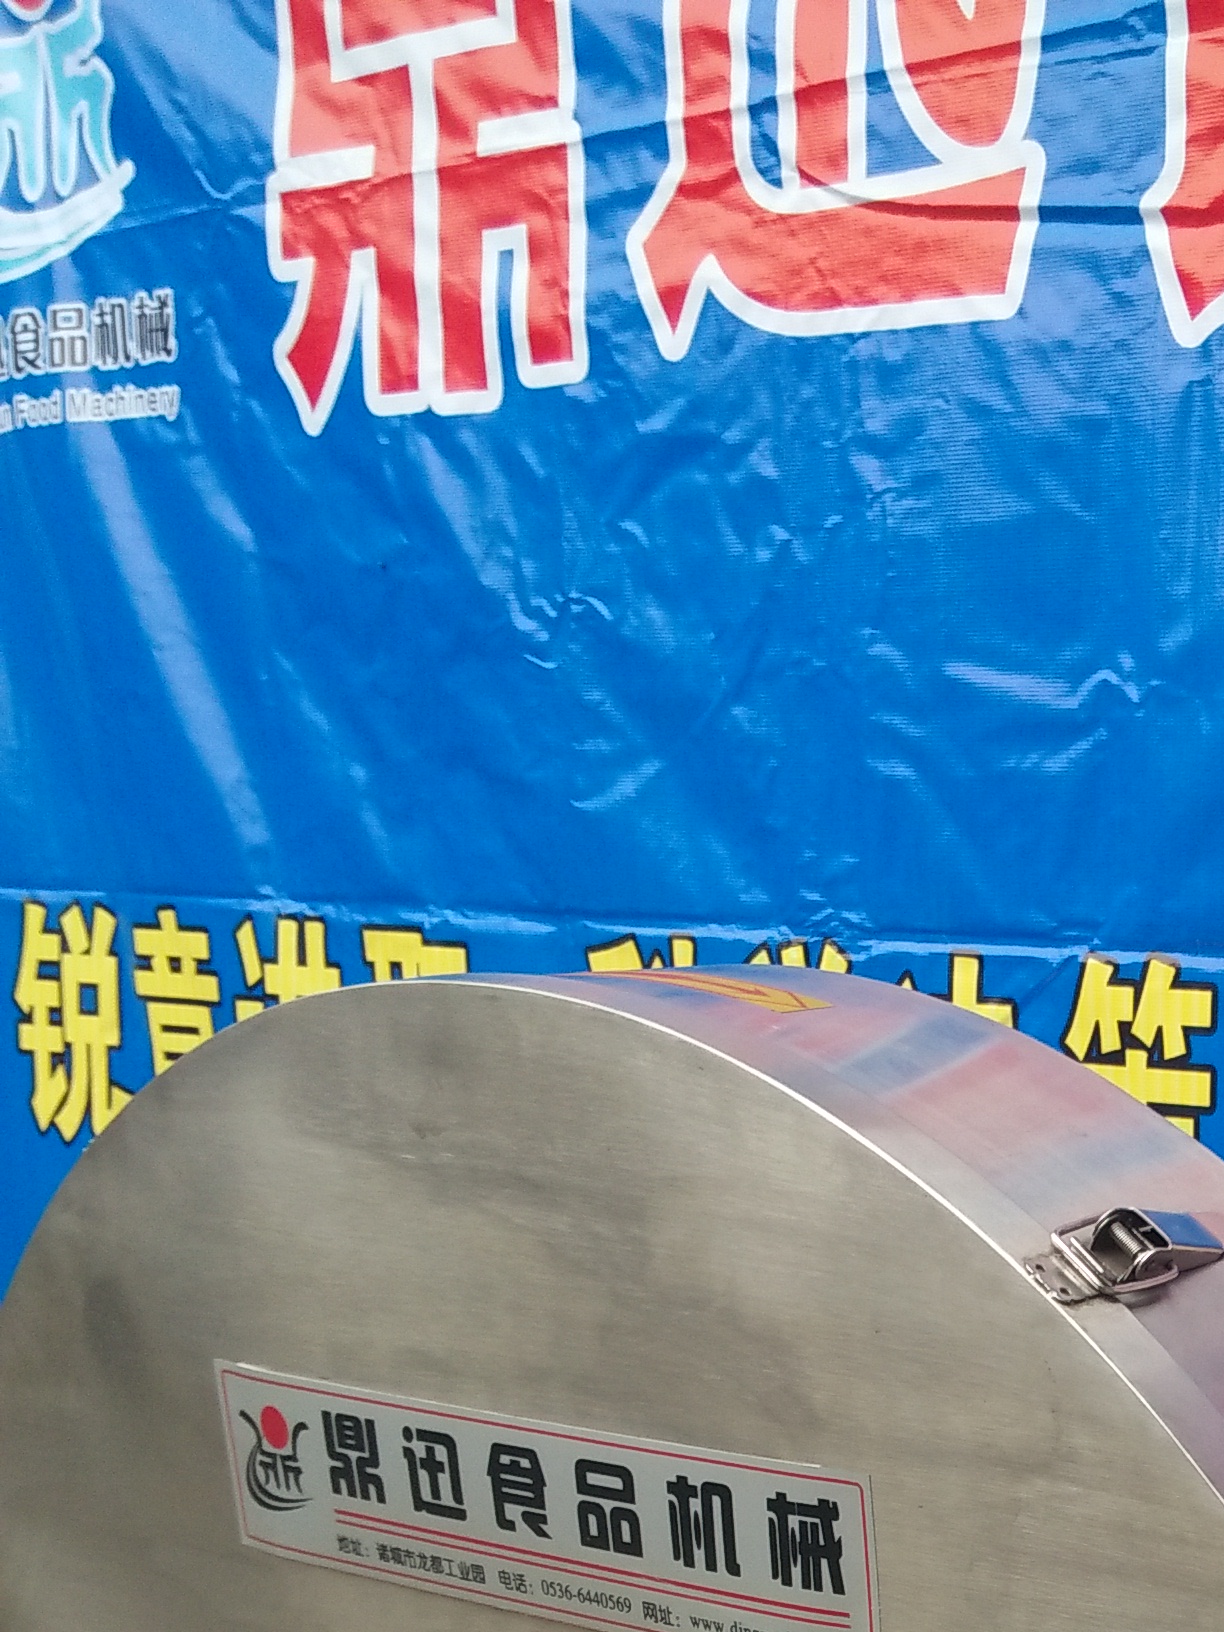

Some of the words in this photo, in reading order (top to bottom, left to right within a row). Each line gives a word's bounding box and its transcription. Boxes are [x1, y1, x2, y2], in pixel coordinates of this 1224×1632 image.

[0, 286, 178, 382] 食品机械
[12, 392, 64, 428] Food
[65, 384, 181, 423] Machinery
[320, 1409, 848, 1597] 鼎迅食品机械
